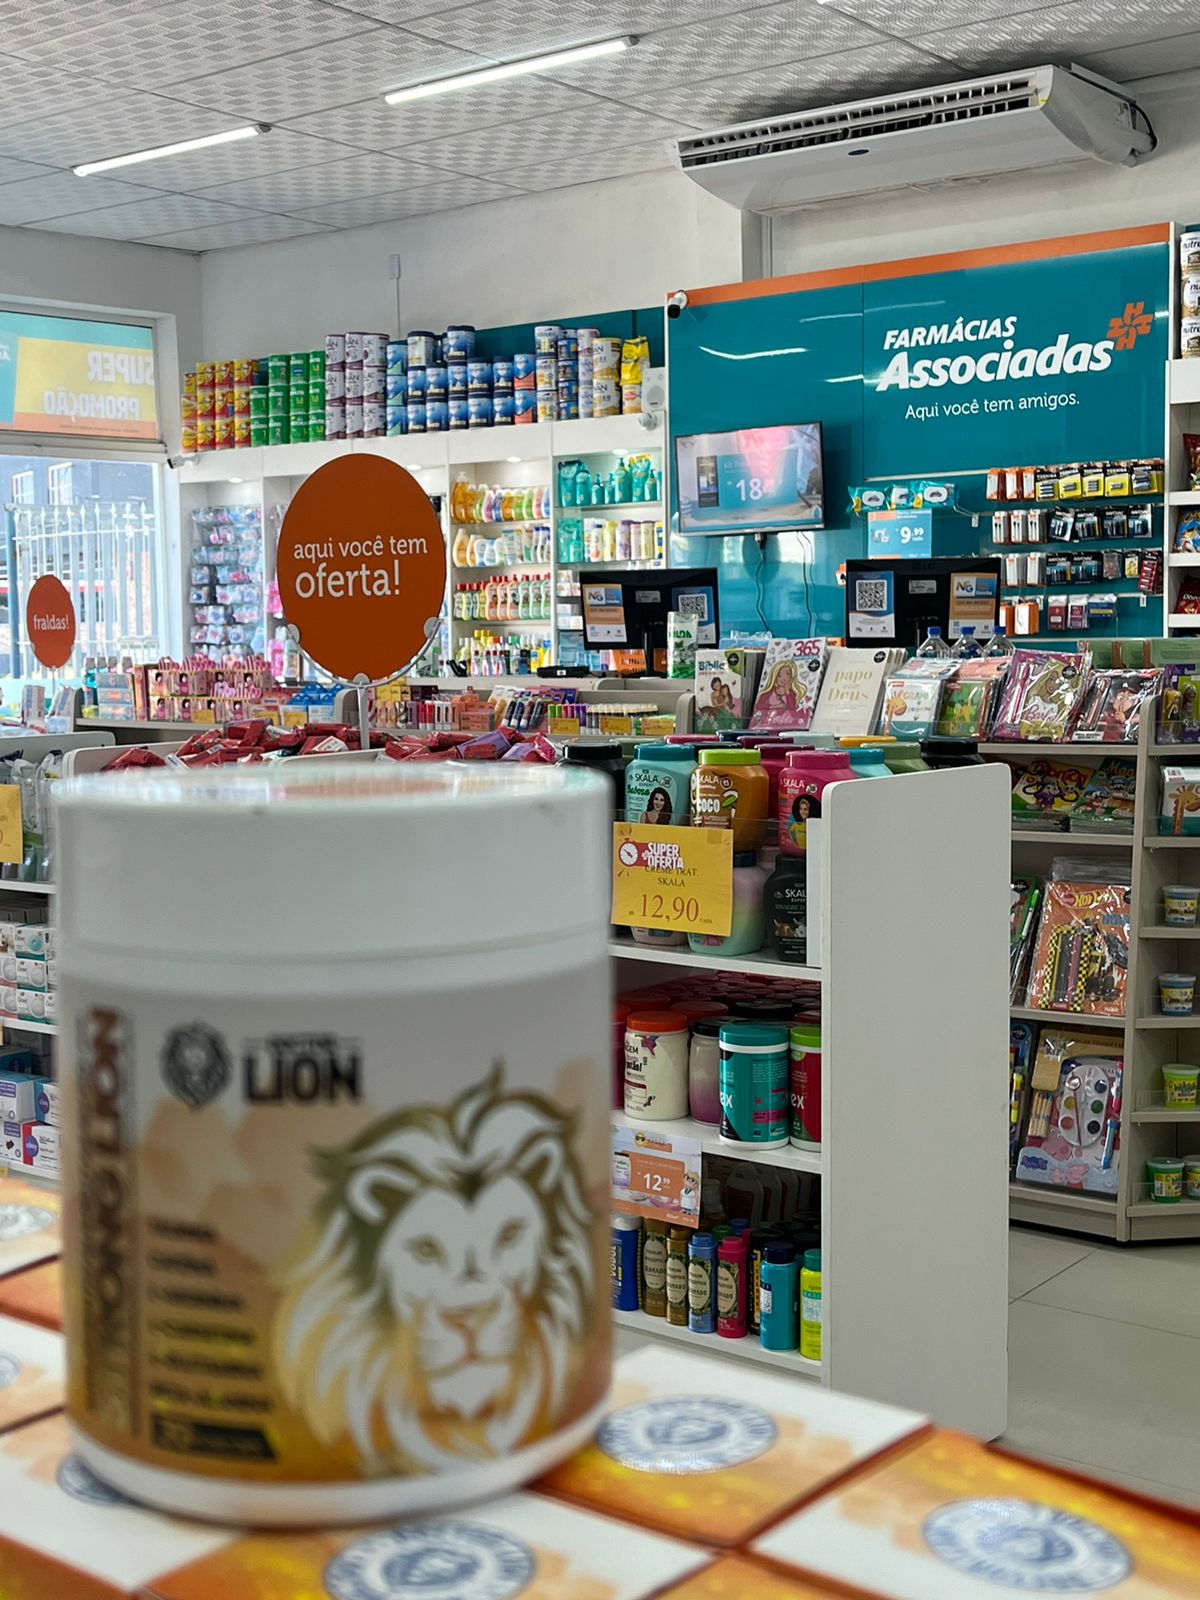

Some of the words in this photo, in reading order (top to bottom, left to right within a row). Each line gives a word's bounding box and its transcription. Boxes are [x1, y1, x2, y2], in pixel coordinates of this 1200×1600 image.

[883, 315, 1018, 350] FARMÁCIAS
[875, 333, 1114, 392] Associadas
[905, 403, 939, 421] Aqui
[943, 399, 980, 416] você
[984, 395, 1014, 412] tem
[1018, 392, 1081, 411] amigos.
[736, 478, 763, 501] 18
[293, 537, 334, 563] aqui
[338, 535, 384, 557] você
[389, 536, 428, 555] tem
[295, 559, 400, 598] oferta!
[33, 614, 69, 631] fraldas!
[794, 639, 822, 657] 365
[833, 671, 873, 683] papo
[828, 687, 870, 701] Deus
[634, 772, 659, 783] SKALA
[783, 778, 806, 789] SKALA
[647, 842, 680, 857] SUPER
[647, 854, 685, 869] OFERTA
[657, 877, 686, 887] SKALA
[640, 893, 699, 923] 12,90
[243, 1053, 361, 1103] LION
